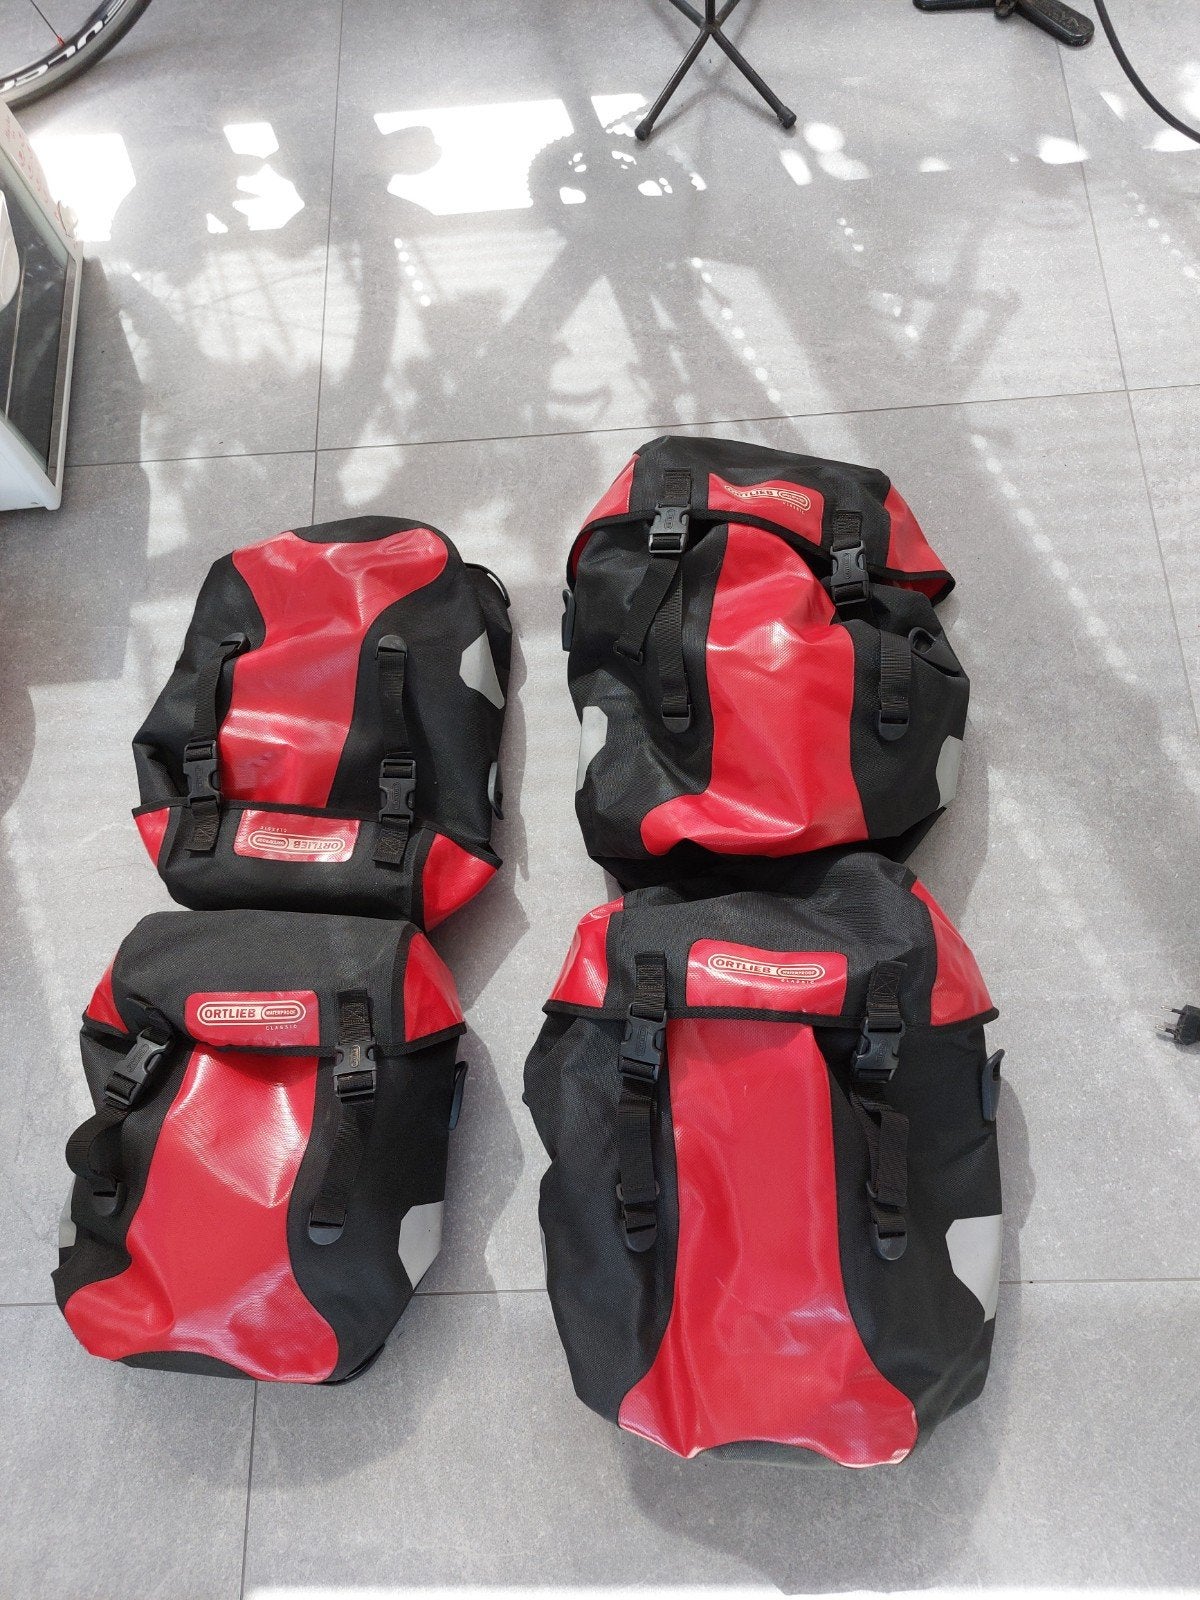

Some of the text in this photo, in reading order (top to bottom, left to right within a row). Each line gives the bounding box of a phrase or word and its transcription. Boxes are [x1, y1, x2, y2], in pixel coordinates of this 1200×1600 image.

[293, 839, 340, 850] ORTLIEB
[715, 957, 772, 974] ORTLIEB
[204, 1007, 297, 1019] ORTLIEB WATERPROOF
